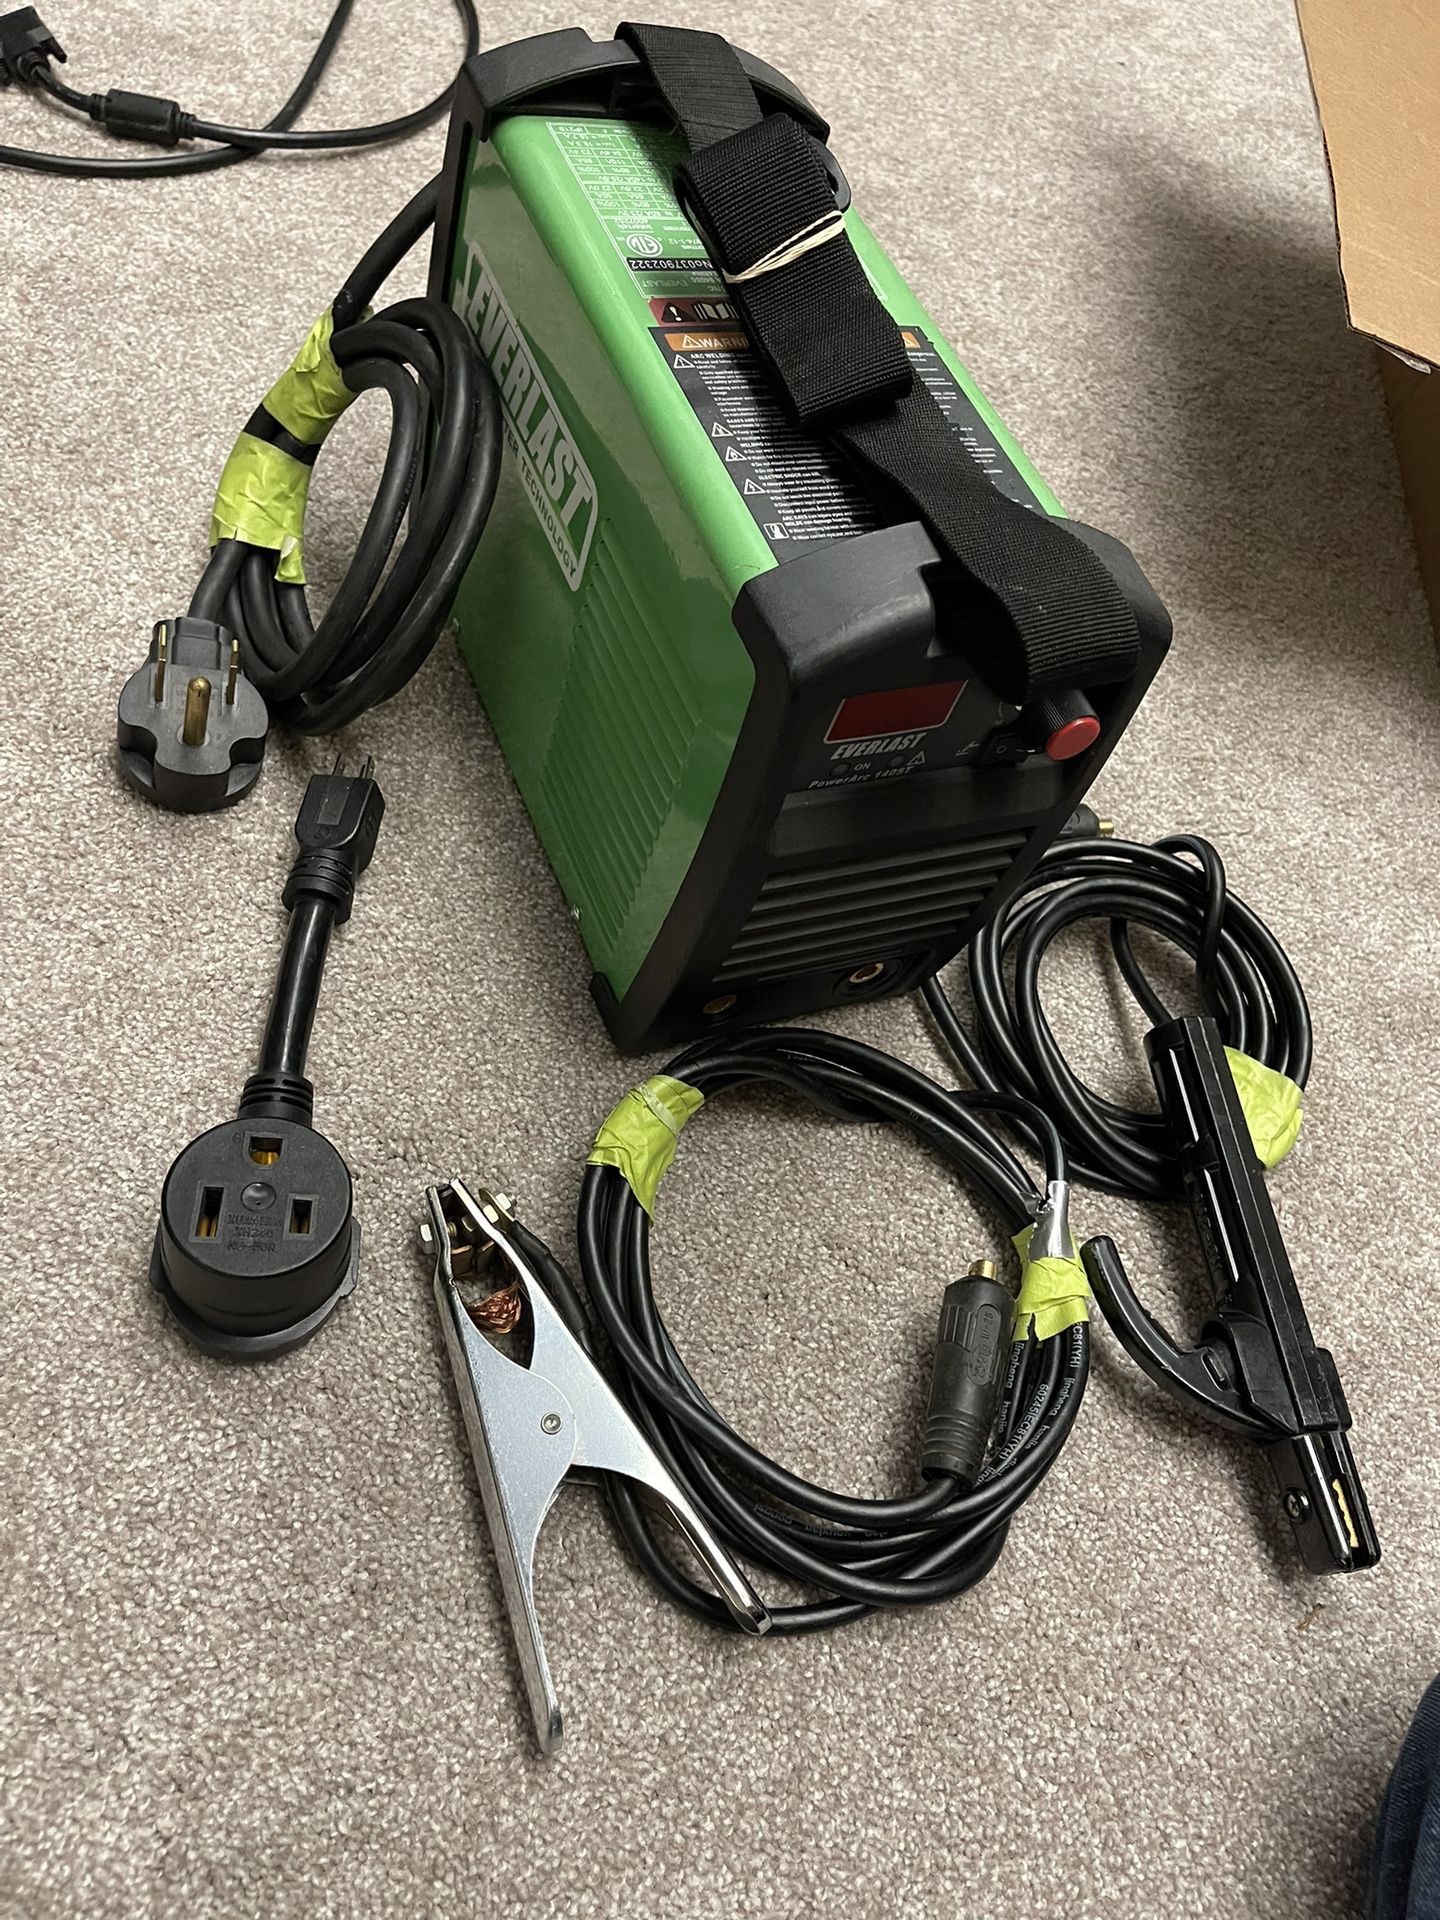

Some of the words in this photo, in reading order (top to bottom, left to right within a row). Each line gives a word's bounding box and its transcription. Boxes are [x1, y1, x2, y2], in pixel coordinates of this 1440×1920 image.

[629, 259, 714, 270] No037902322
[701, 338, 749, 348] WARNI
[467, 269, 592, 527] EVERLAST
[521, 456, 576, 578] TECHNOLOGY
[830, 732, 928, 760] EVERLAST
[854, 762, 871, 771] ON
[808, 774, 872, 789] PowerArc
[1070, 1322, 1083, 1368] C81(YH)
[999, 1383, 1050, 1460] 60245IEC81(YH)
